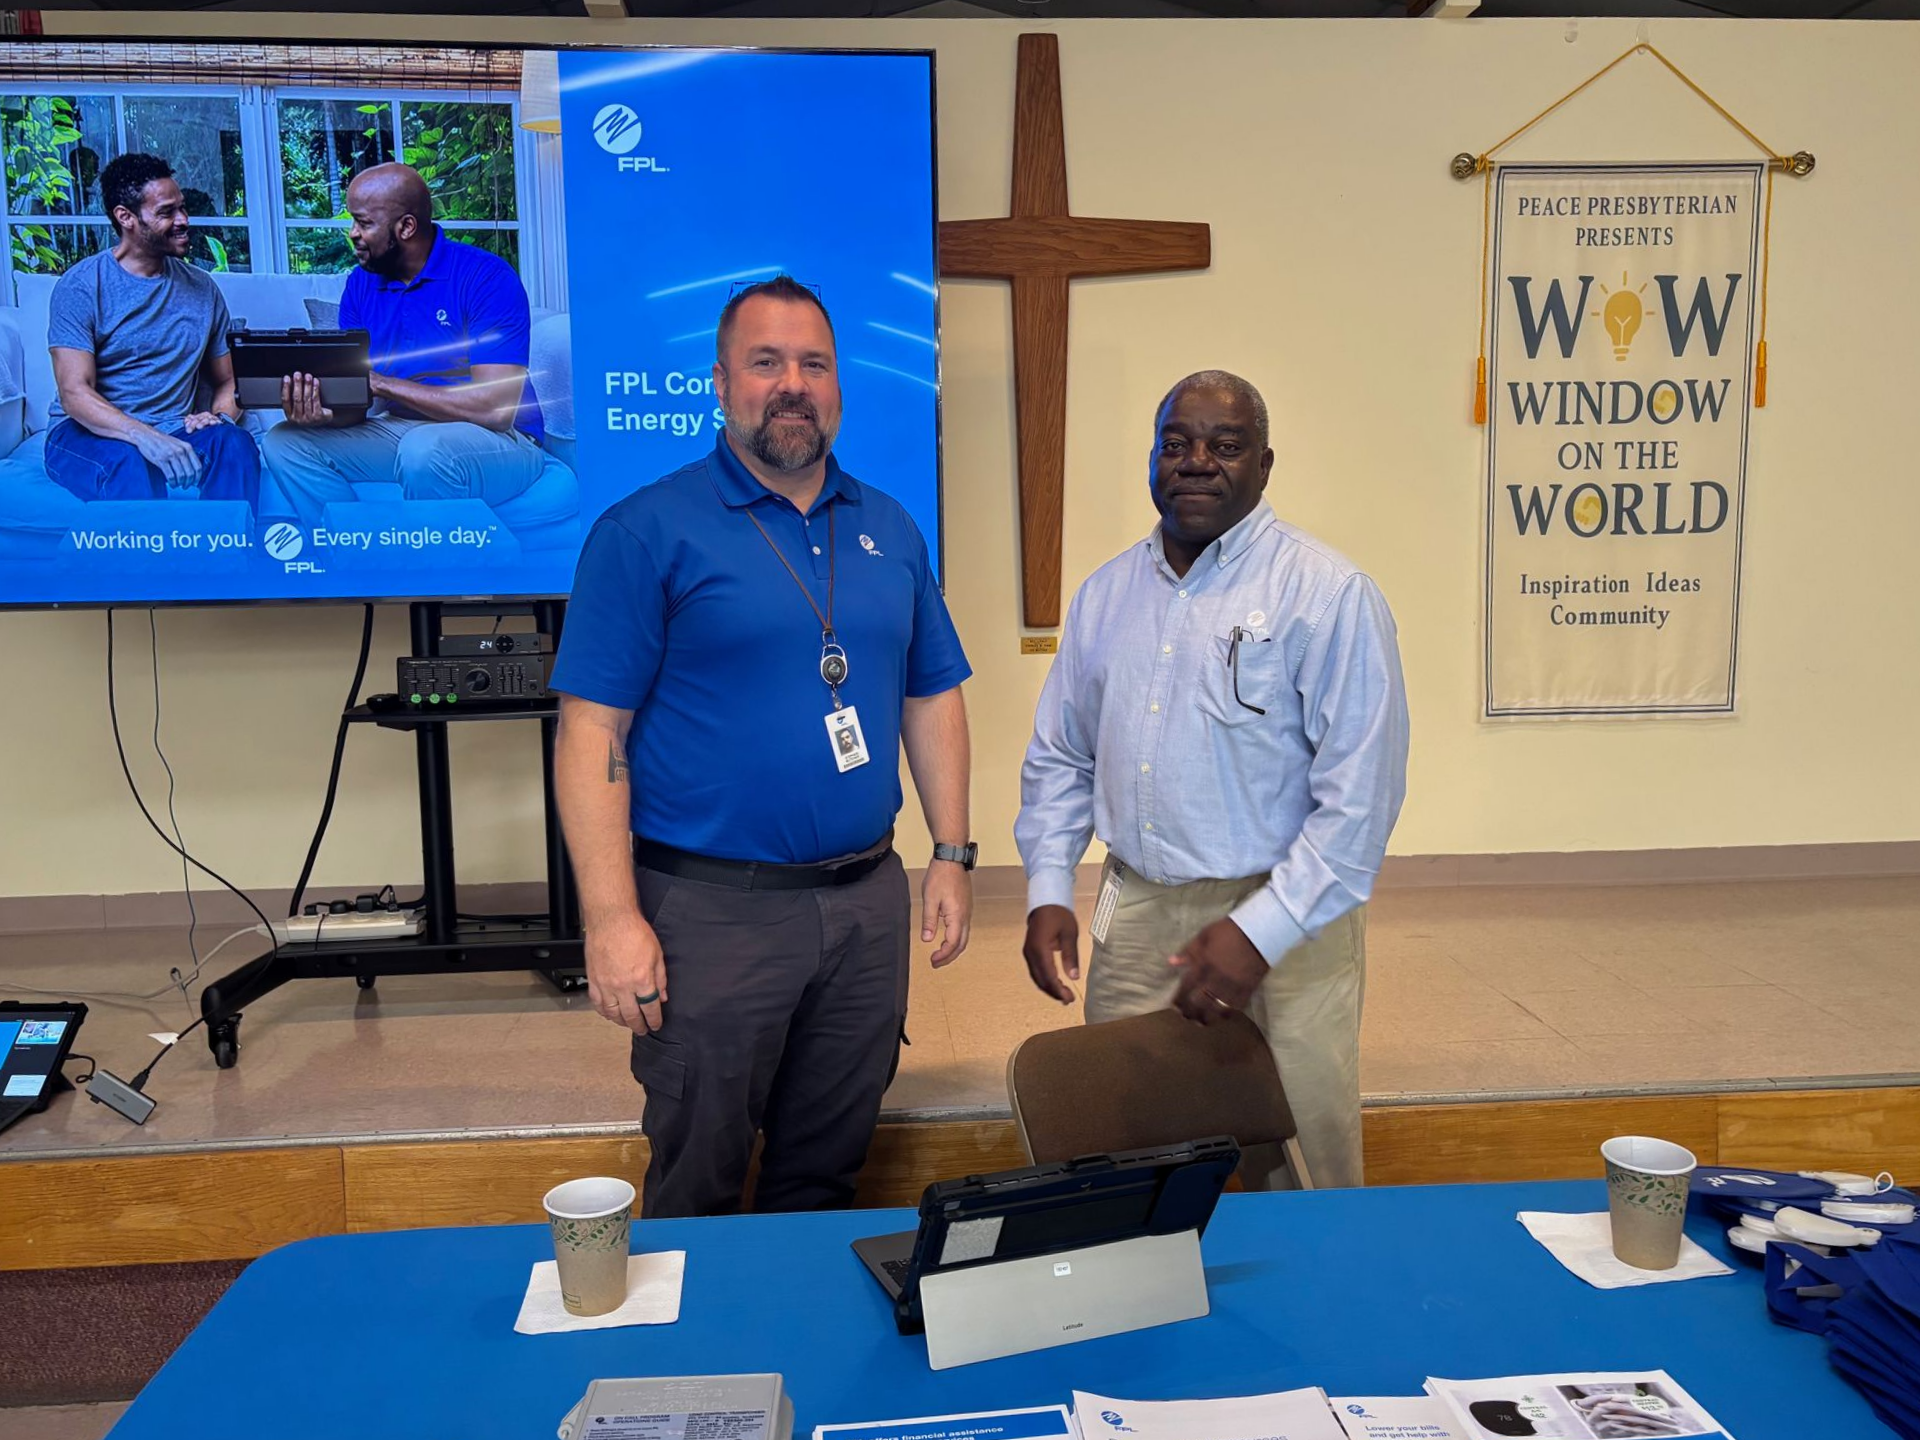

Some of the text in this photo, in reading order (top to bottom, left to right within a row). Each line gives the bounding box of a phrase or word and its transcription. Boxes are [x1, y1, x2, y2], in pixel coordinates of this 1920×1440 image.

[1518, 195, 1738, 216] PEACE PRESBYTERIAN
[1576, 227, 1674, 246] PRESENTS
[605, 372, 657, 395] FPL
[1507, 379, 1731, 425] WINDOW
[607, 408, 704, 437] Energy
[1557, 440, 1679, 470] ON THE
[1506, 481, 1729, 538] WORLD
[71, 531, 164, 553] Working
[170, 531, 201, 548] for
[207, 532, 253, 552] you.
[313, 528, 372, 550] Every
[379, 526, 442, 548] single
[1520, 572, 1701, 599] Inspiration Ideas
[1550, 605, 1670, 630] Community
[480, 640, 493, 649] 24
[901, 1431, 946, 1440] financial
[1396, 1425, 1418, 1433] your
